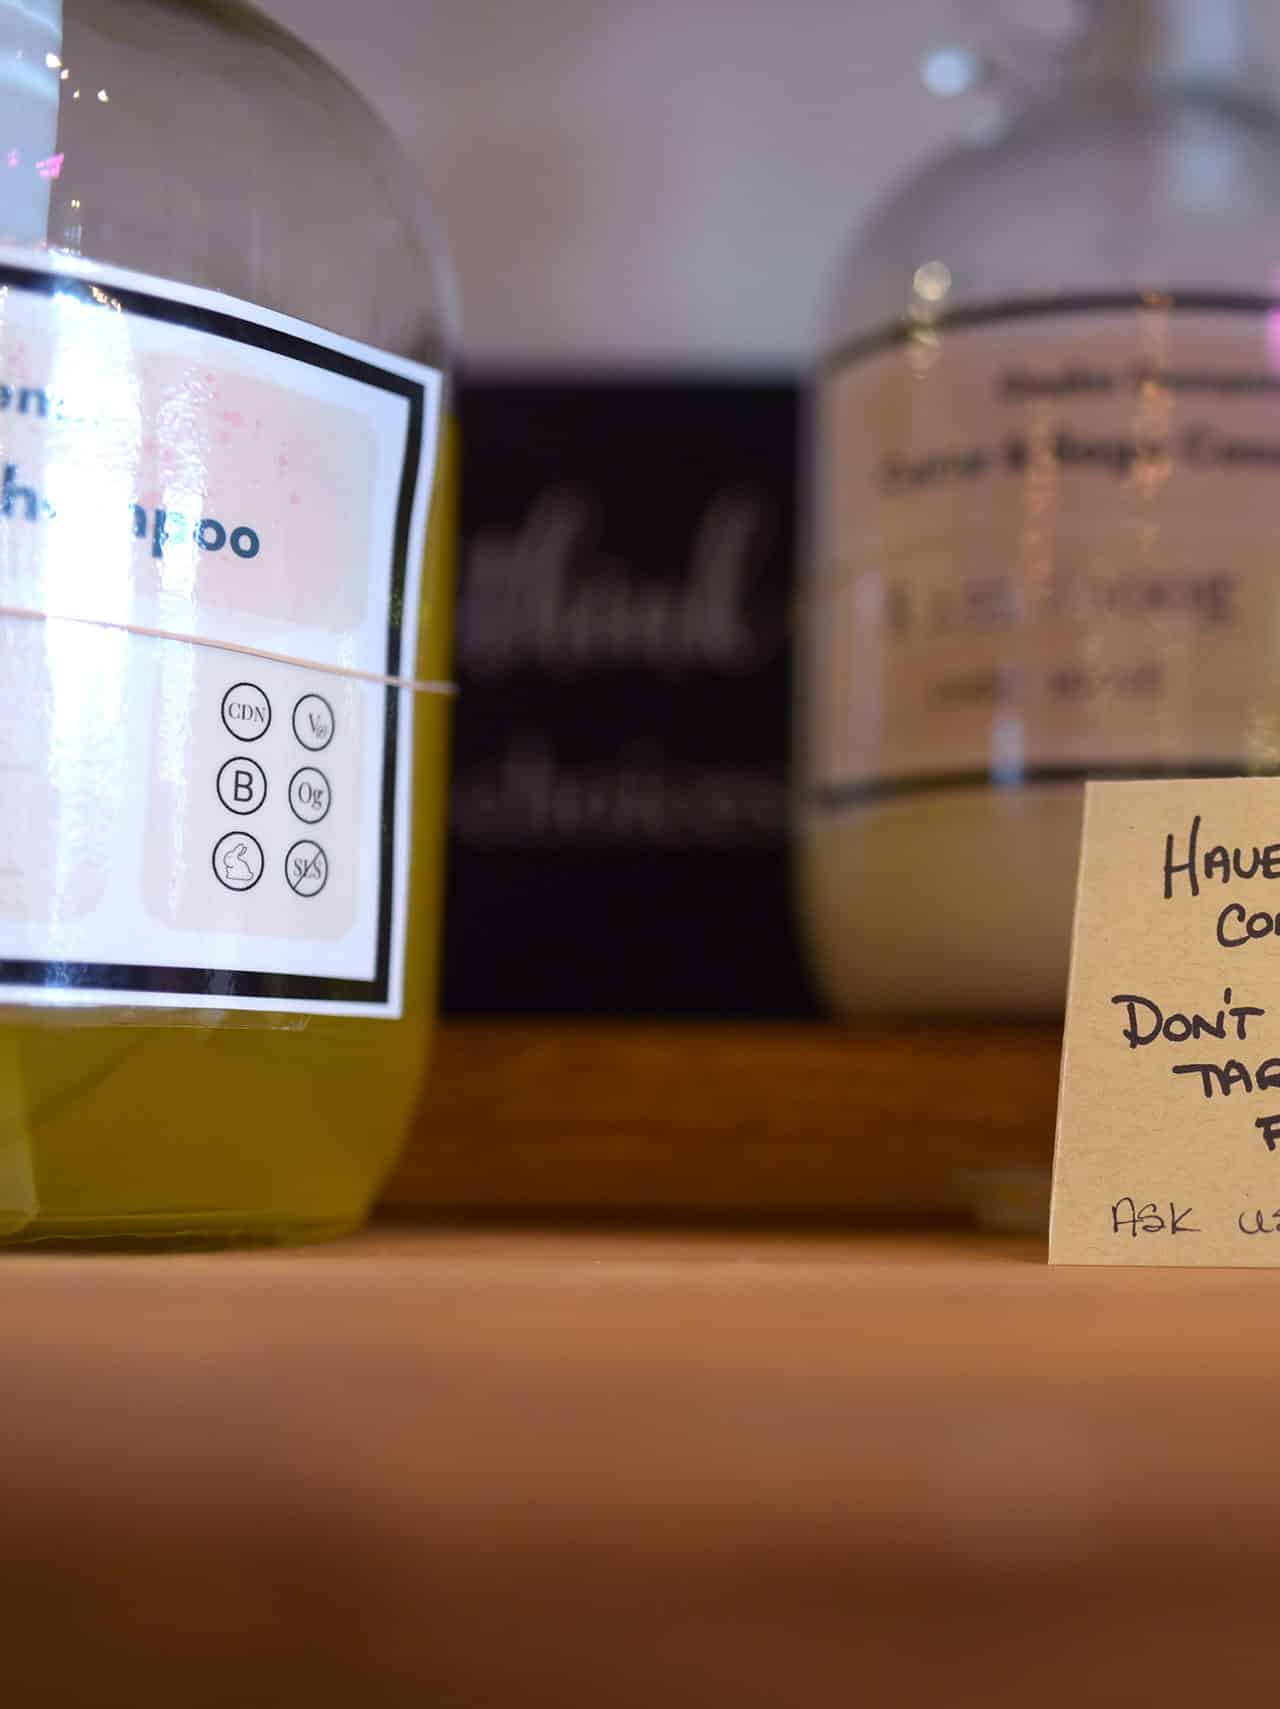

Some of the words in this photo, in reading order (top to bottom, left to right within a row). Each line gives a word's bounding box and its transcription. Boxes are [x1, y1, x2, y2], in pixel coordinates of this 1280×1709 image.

[228, 702, 266, 723] CDN
[233, 769, 254, 803] B
[298, 781, 324, 811] Og
[1110, 987, 1266, 1050] DON'T
